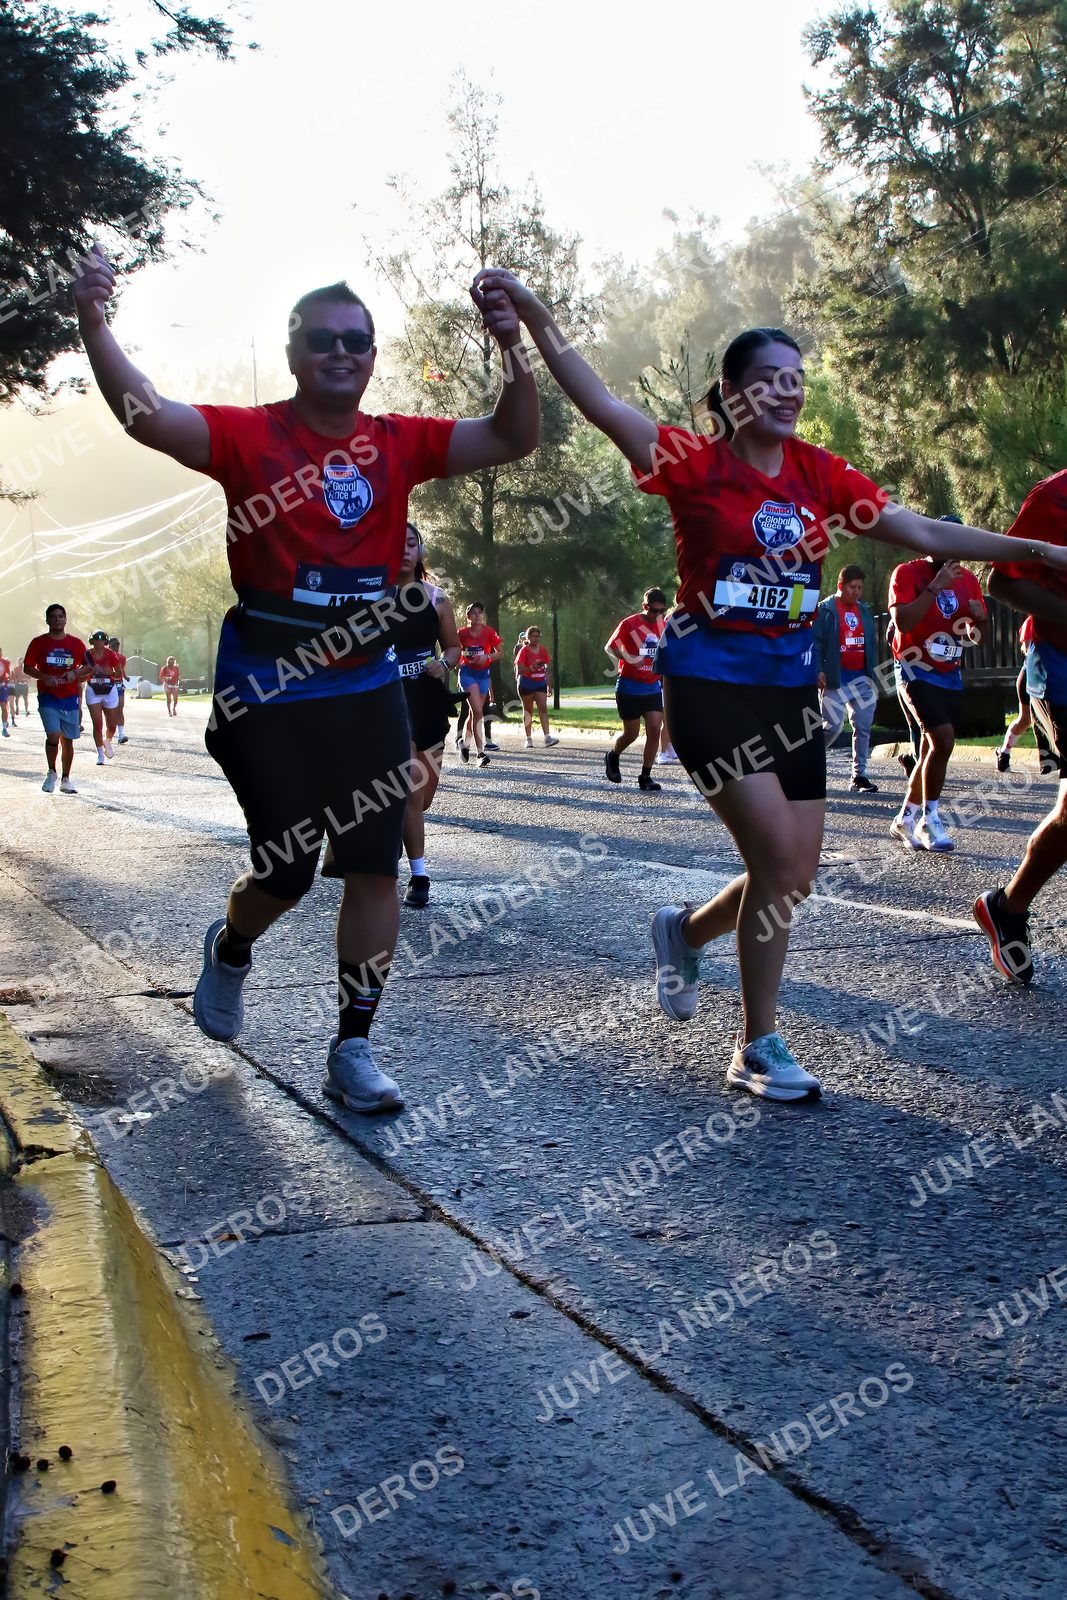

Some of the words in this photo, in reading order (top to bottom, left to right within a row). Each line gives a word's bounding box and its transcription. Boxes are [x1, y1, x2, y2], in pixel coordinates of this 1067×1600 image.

[332, 480, 356, 491] Global
[329, 491, 349, 500] Race
[766, 505, 791, 515] BIMBO
[761, 521, 782, 530] Race
[765, 515, 791, 526] Global
[748, 586, 789, 610] 4162
[402, 660, 426, 676] 4535
